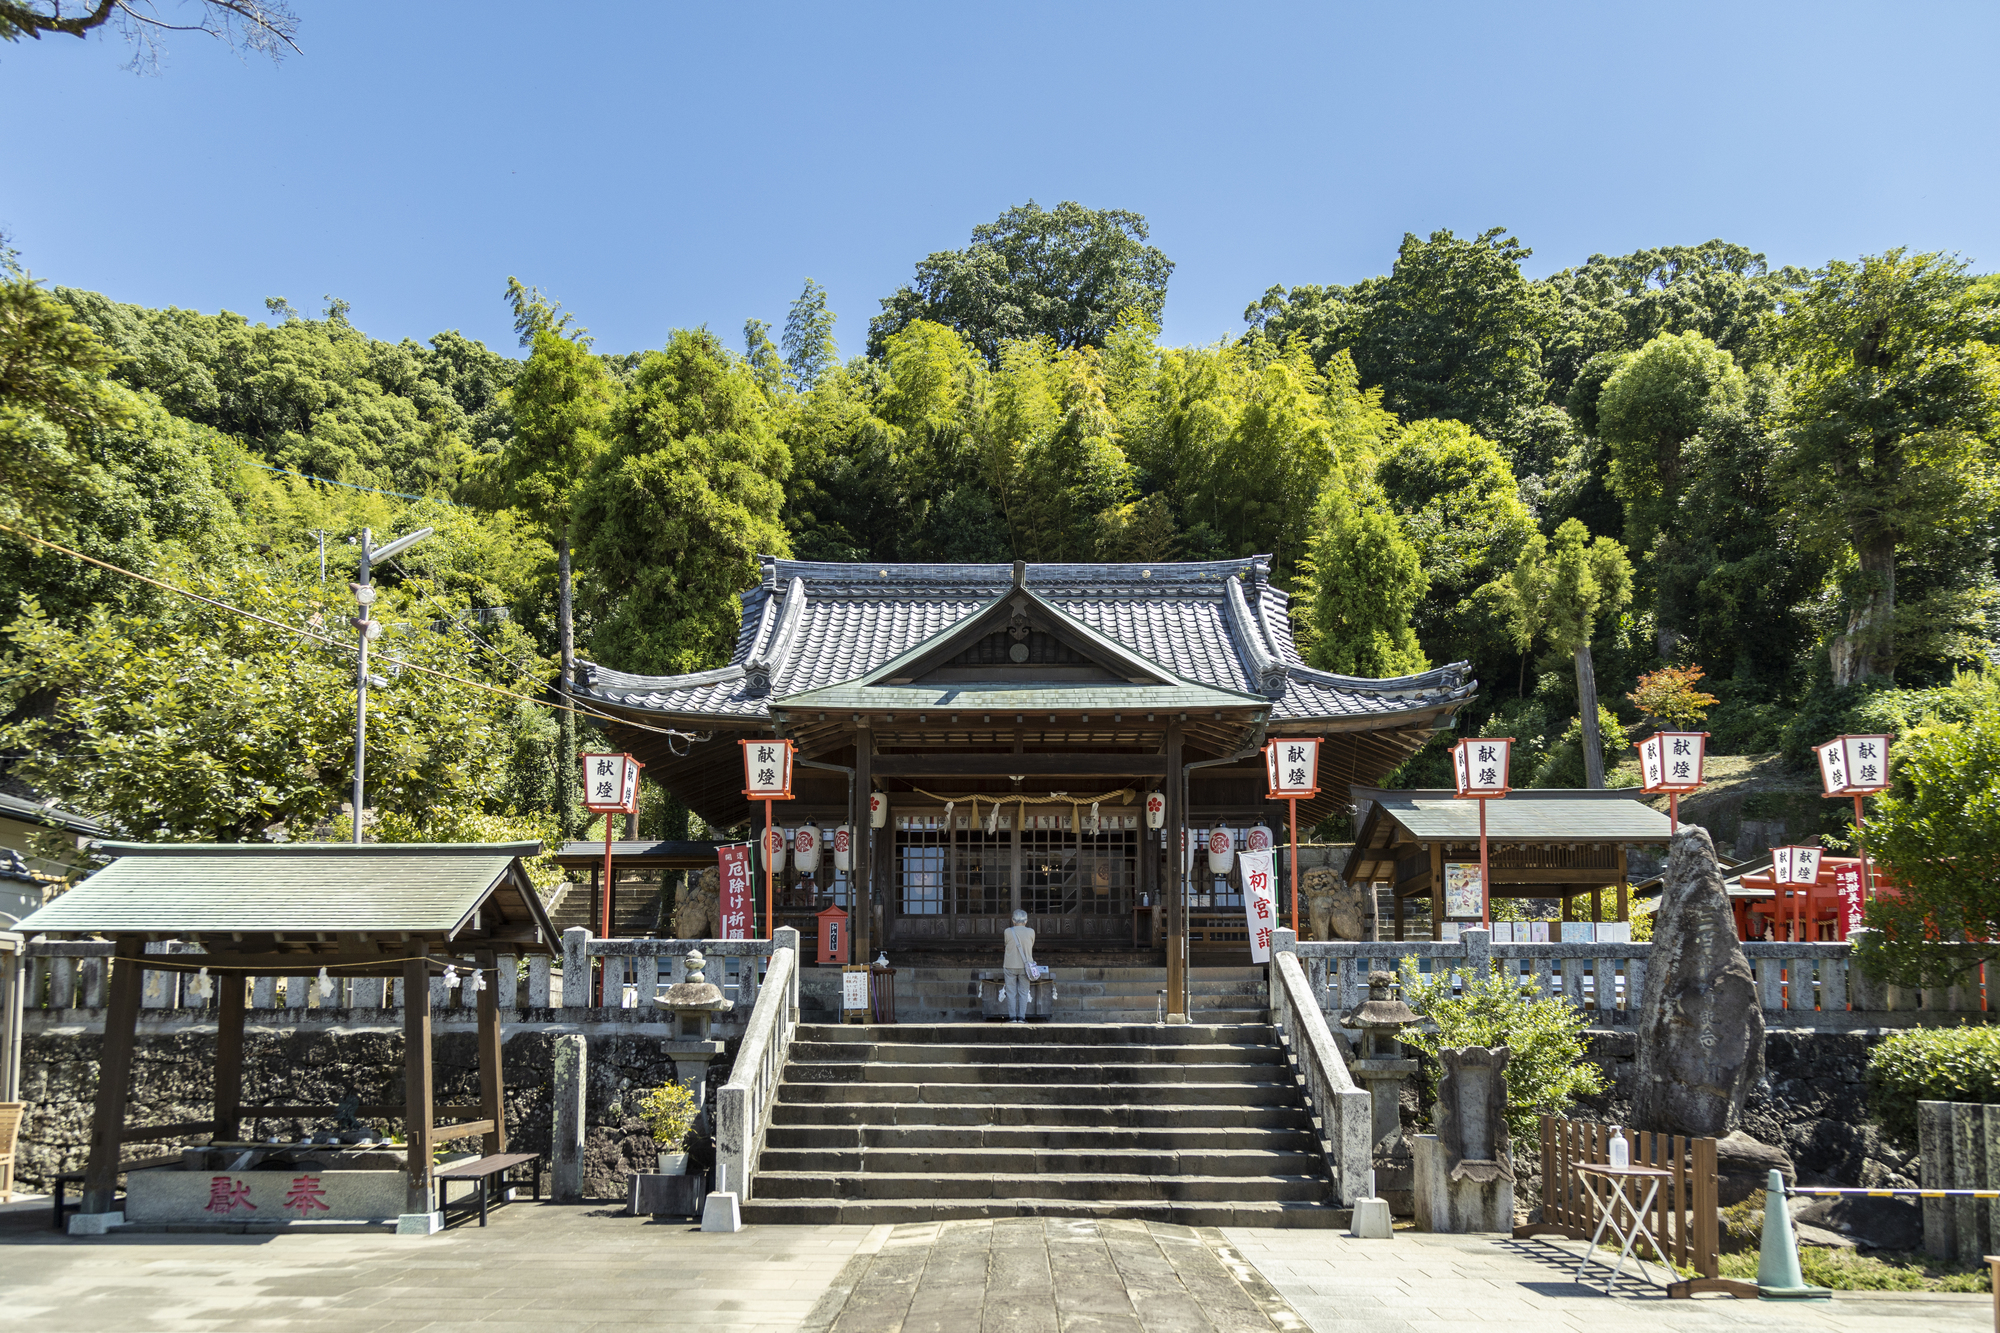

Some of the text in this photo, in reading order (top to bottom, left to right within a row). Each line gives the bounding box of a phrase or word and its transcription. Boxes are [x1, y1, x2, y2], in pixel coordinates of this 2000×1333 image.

[595, 758, 615, 798] 献燈
[757, 745, 776, 786] 献燈
[1287, 745, 1307, 786] 献燈
[1478, 745, 1497, 785] 献燈
[1672, 738, 1691, 779] 献燈
[1858, 741, 1878, 782] 献燈
